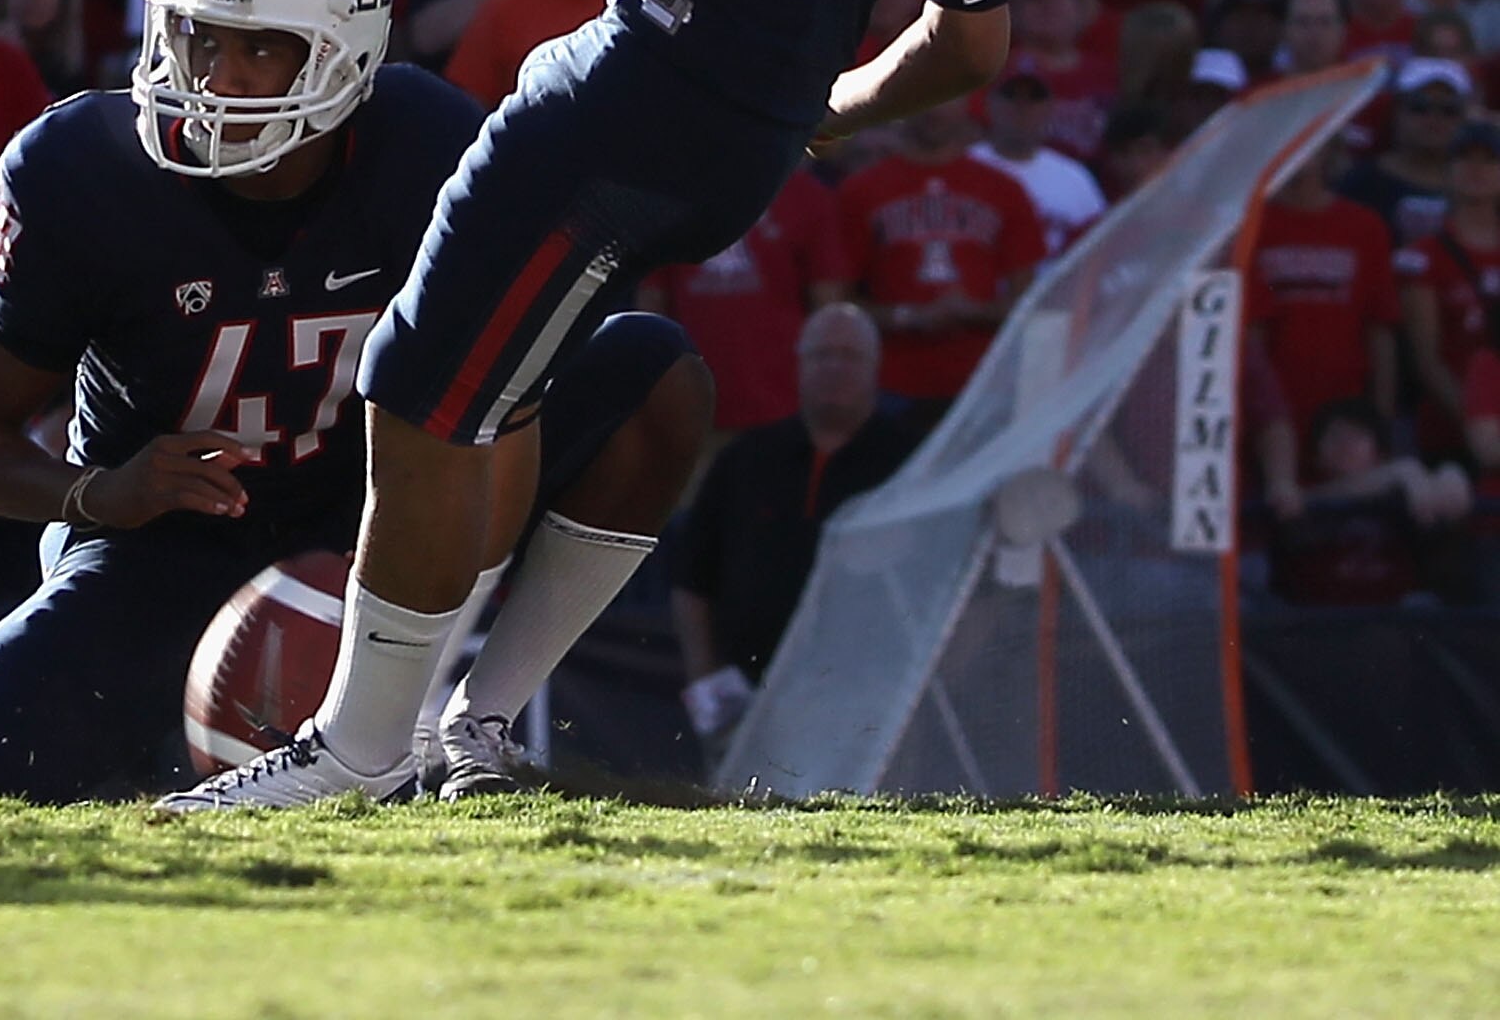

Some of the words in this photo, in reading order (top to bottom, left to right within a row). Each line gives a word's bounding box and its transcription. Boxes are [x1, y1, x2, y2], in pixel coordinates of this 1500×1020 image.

[257, 267, 292, 299] A
[176, 306, 383, 467] 47
[1186, 279, 1230, 543] GILMAN
